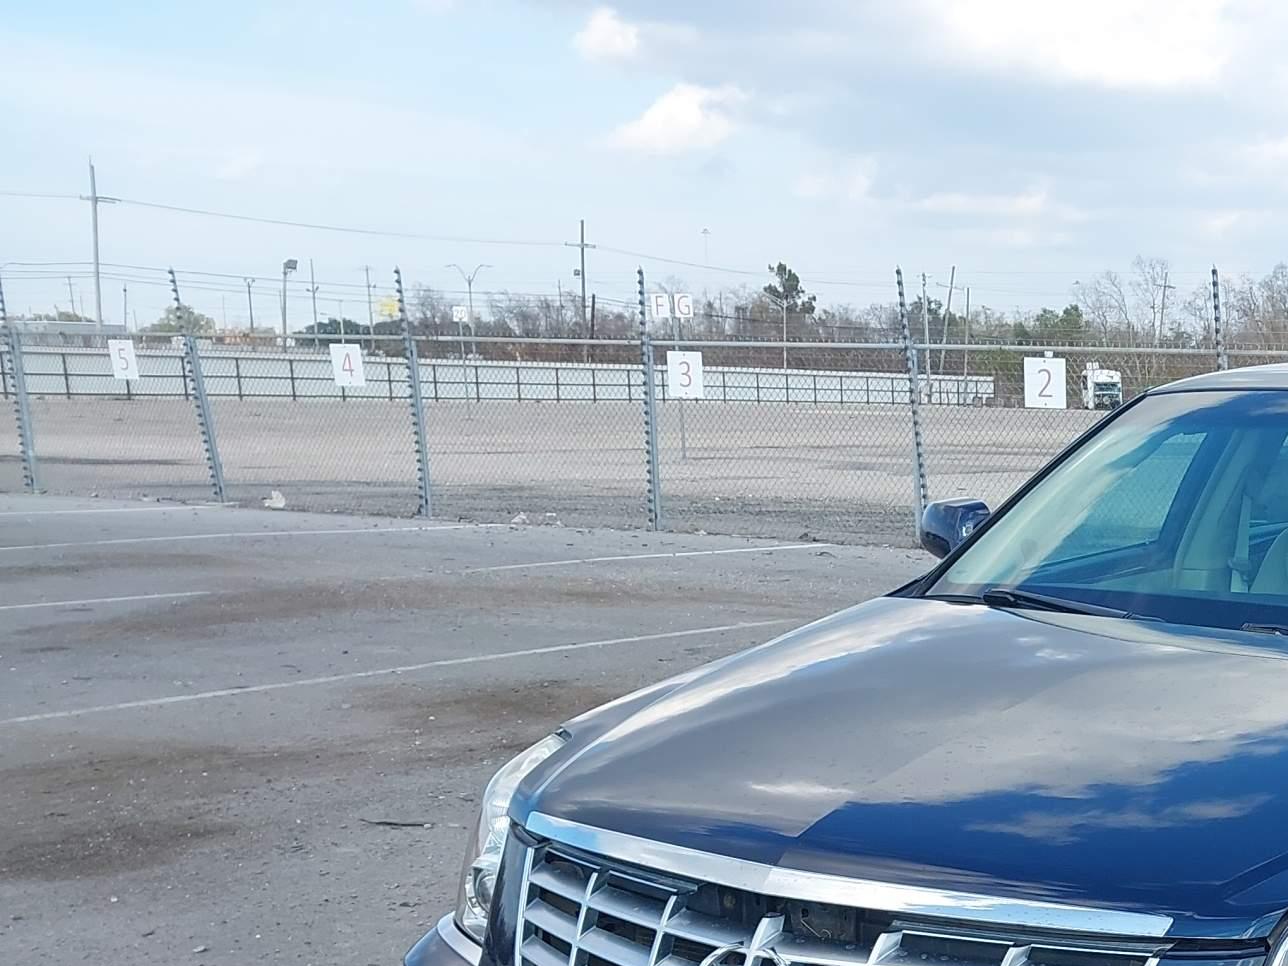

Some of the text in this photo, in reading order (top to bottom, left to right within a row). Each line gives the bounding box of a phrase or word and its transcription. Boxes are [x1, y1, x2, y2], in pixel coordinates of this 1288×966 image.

[655, 295, 665, 316] F
[677, 295, 691, 316] G
[118, 348, 129, 370] 5
[342, 352, 354, 377] 4
[679, 361, 691, 388] 3
[1038, 368, 1053, 397] 2
